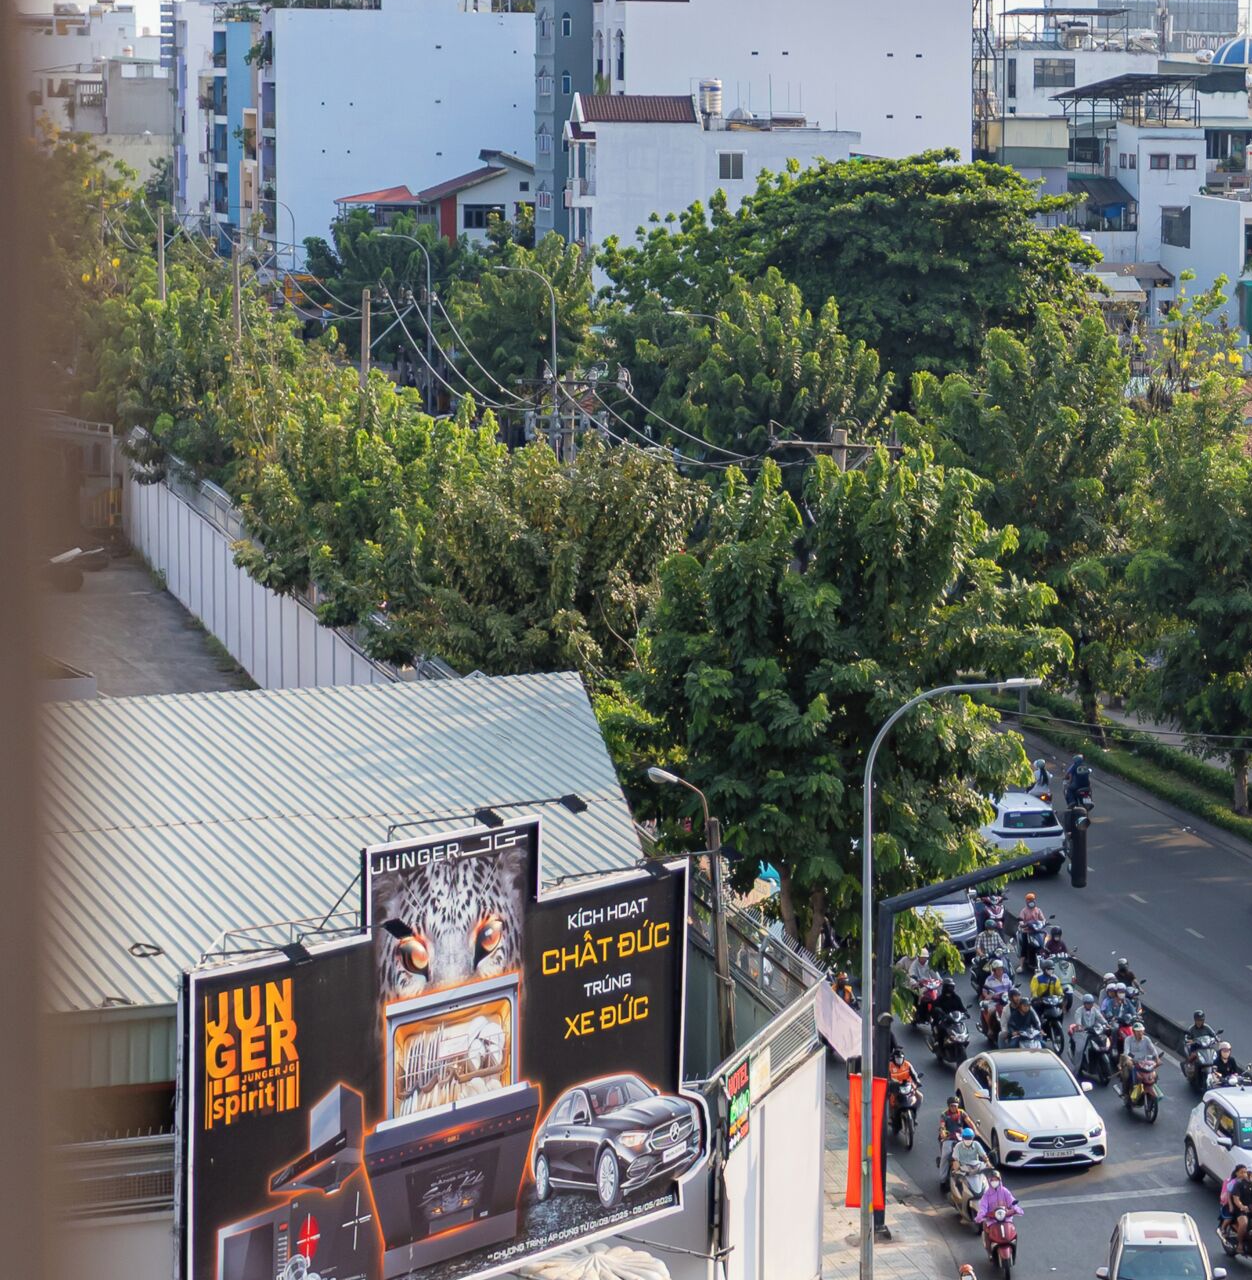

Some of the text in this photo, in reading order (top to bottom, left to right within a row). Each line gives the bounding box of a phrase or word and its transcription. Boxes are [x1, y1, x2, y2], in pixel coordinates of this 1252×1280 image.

[567, 897, 648, 930] KÍCH HOẠT
[542, 919, 670, 975] CHẤT ĐỨC
[583, 973, 632, 997] TRÚNG
[206, 978, 292, 1038] JUN
[564, 993, 649, 1040] XE ĐỨC
[206, 1020, 299, 1079] GER
[241, 1063, 296, 1084] JUNGER JG
[213, 1081, 275, 1125] spirit
